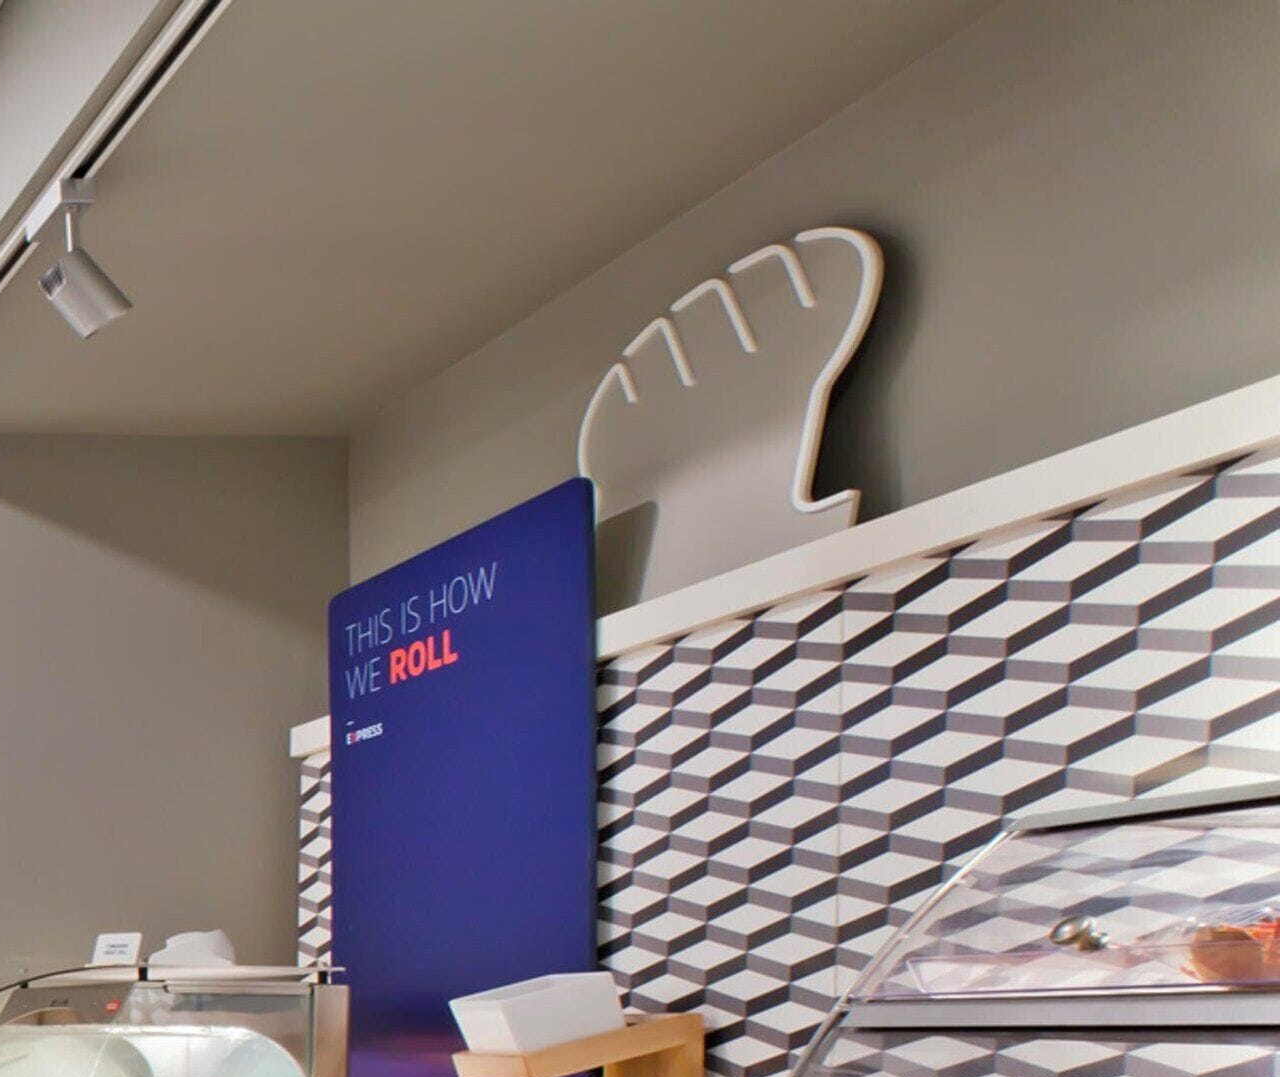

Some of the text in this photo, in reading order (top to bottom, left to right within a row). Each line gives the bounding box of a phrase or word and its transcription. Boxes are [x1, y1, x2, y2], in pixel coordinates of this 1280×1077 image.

[345, 561, 498, 656] THIS IS HOW
[345, 629, 458, 699] WE ROLL
[346, 722, 384, 745] EXPRESS
